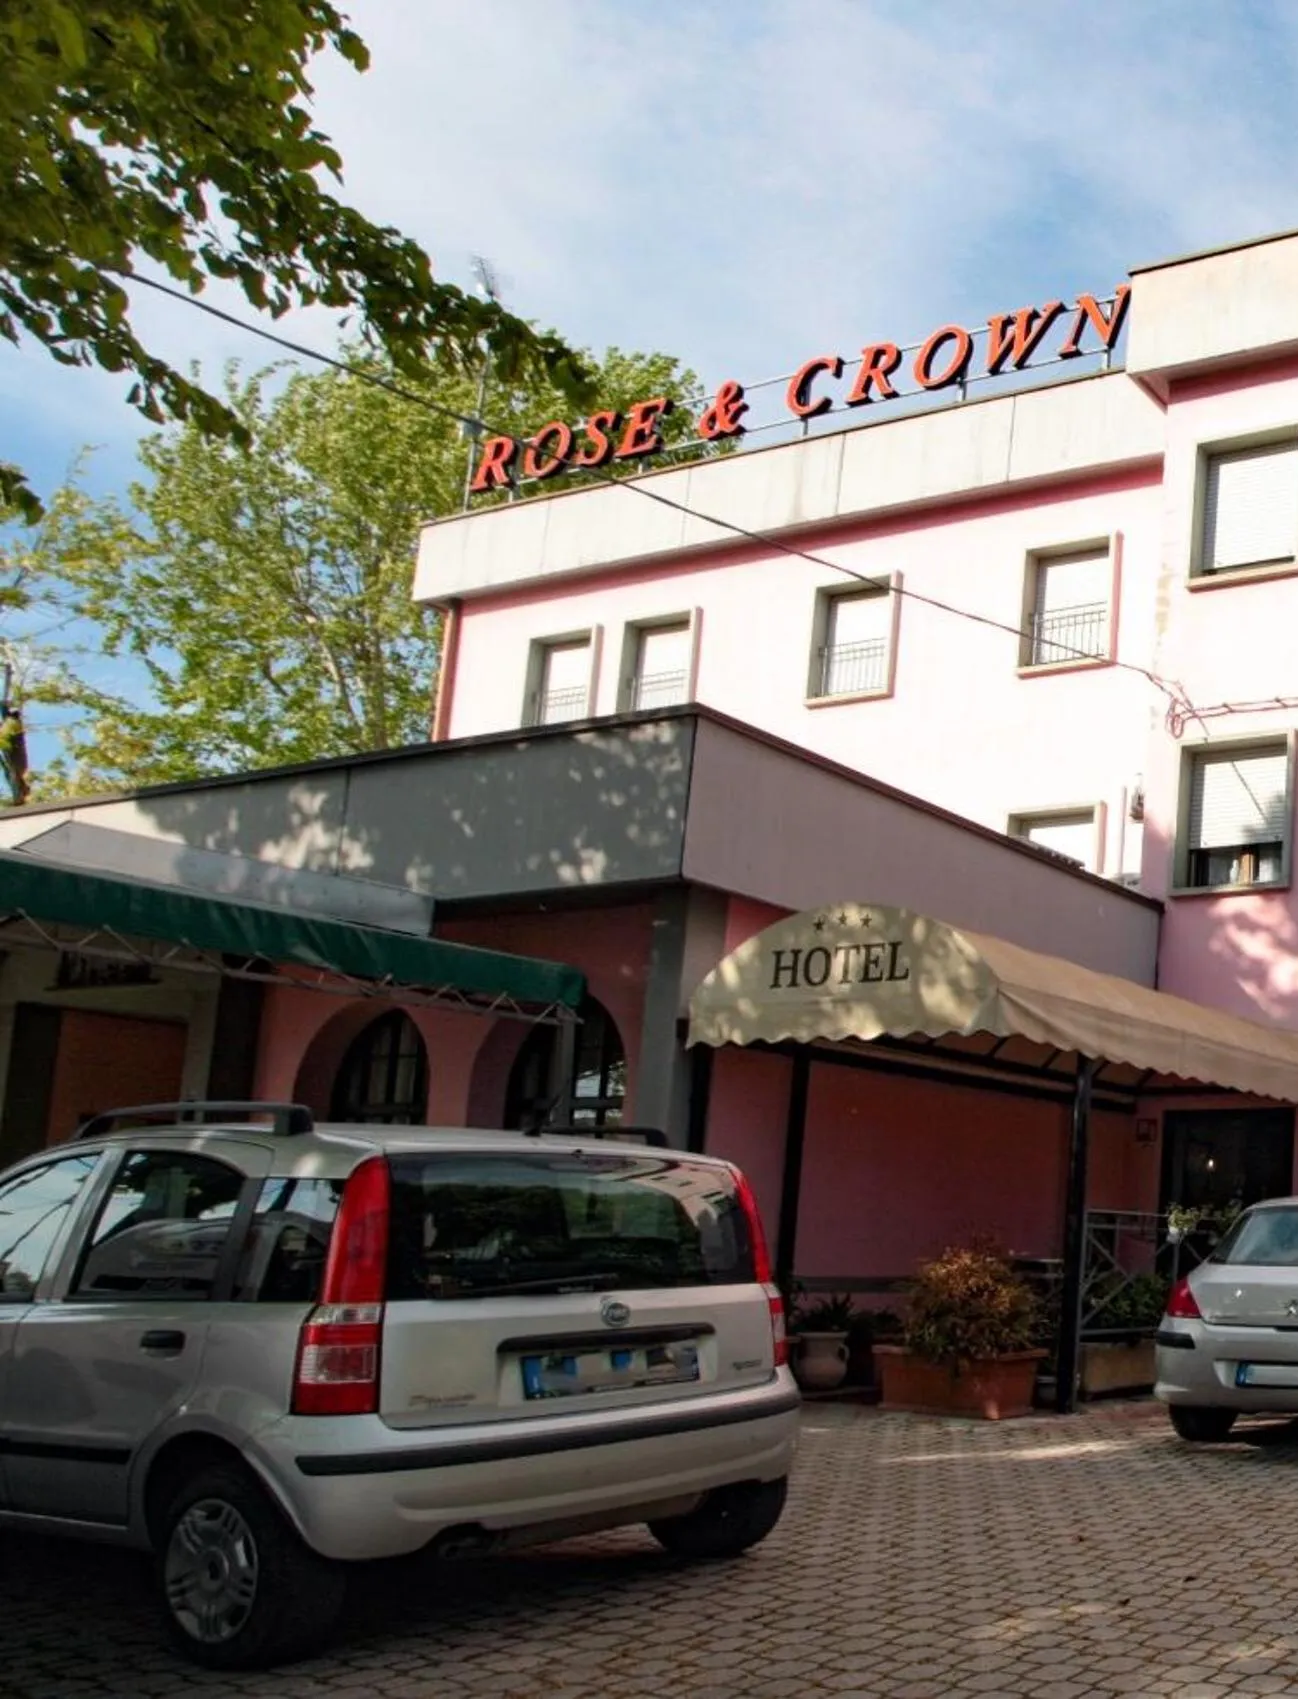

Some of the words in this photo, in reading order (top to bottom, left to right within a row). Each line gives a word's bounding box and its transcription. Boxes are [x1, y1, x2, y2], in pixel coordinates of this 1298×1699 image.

[470, 398, 672, 491] ROSE
[699, 380, 747, 441] &
[786, 284, 1131, 417] CROWN
[769, 941, 909, 989] HOTEL
